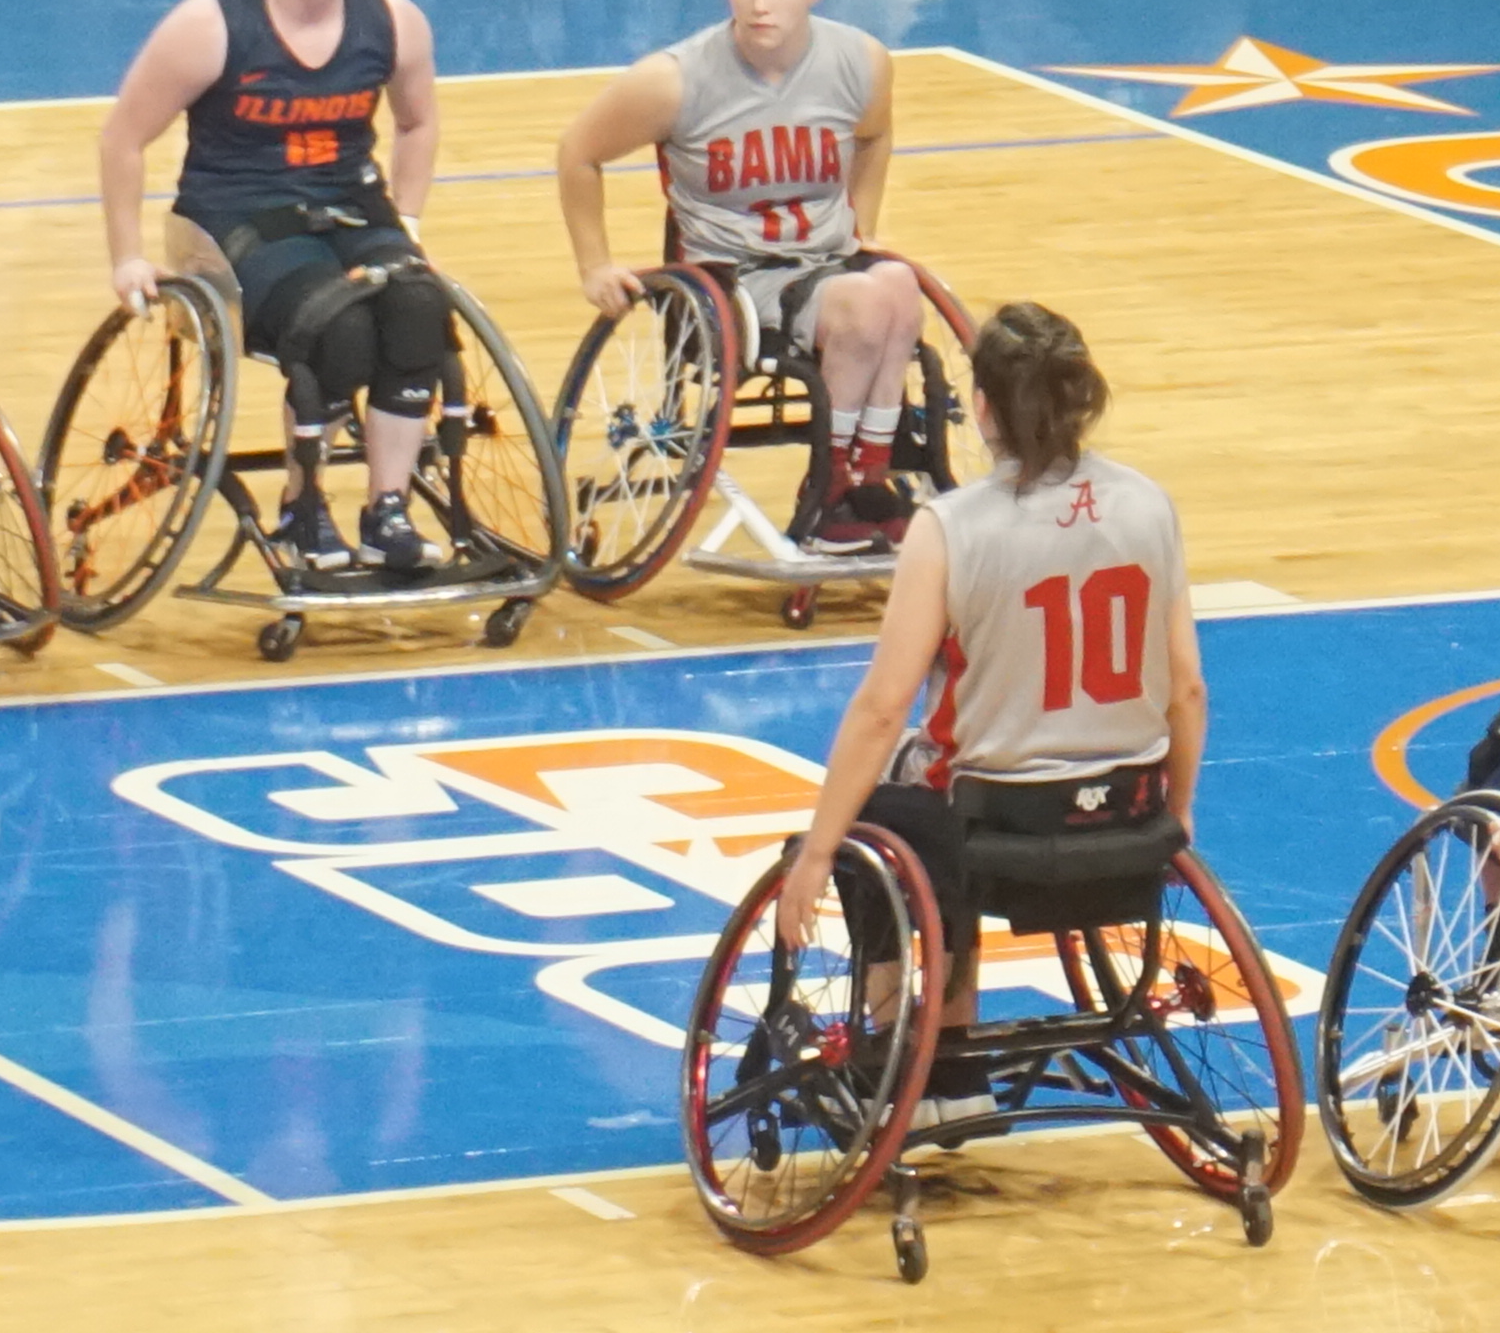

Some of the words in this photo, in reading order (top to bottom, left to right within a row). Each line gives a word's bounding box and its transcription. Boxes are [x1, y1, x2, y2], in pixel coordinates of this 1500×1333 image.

[234, 90, 374, 124] ILLINOIS
[707, 125, 841, 193] BAMA
[1024, 563, 1153, 713] 10
